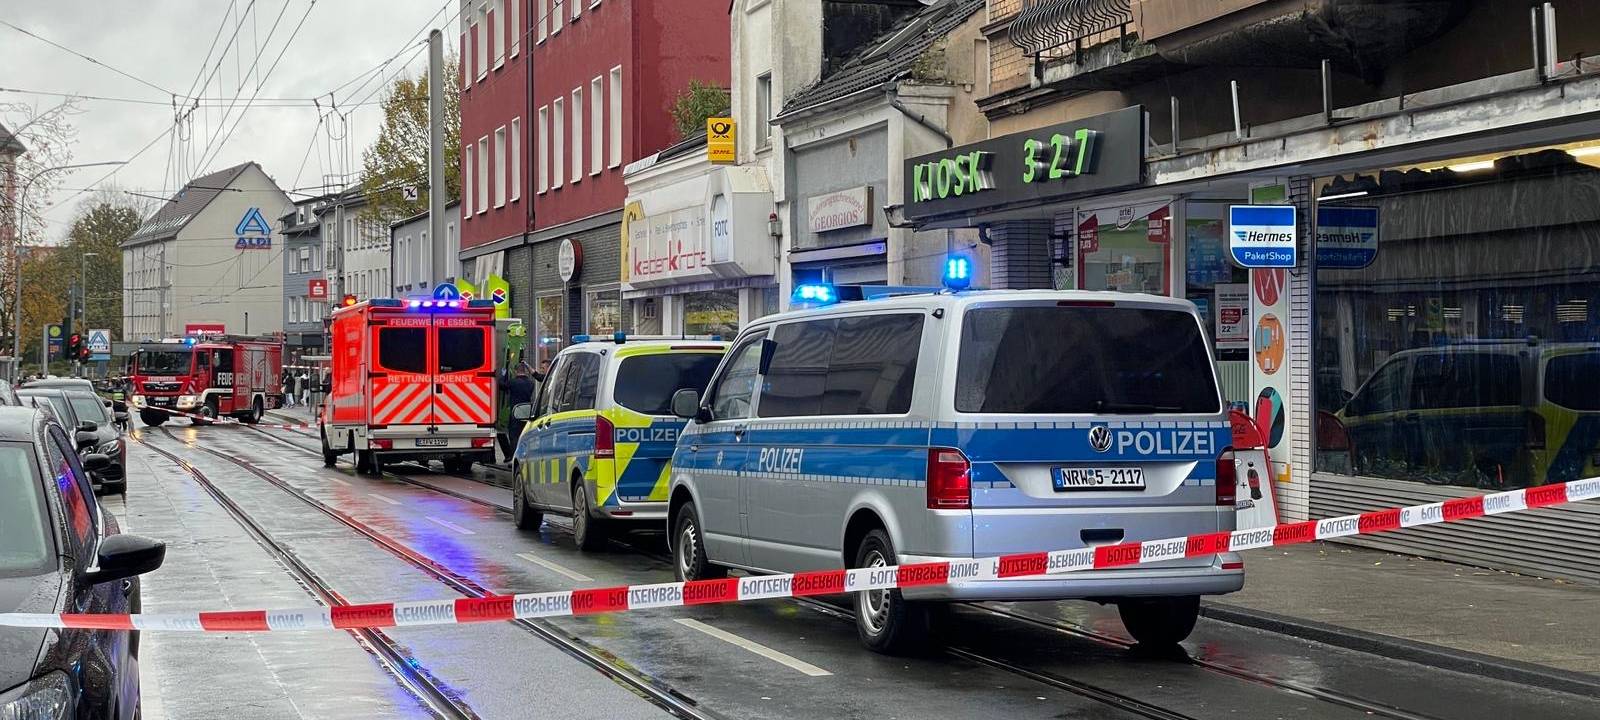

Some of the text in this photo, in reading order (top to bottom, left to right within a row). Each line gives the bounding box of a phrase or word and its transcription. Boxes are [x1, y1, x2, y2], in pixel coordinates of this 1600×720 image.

[913, 128, 1090, 203] KIOSK 327
[814, 210, 859, 230] GEORGIOS
[235, 238, 271, 249] ALDI
[1248, 231, 1293, 242] Hermes
[1244, 251, 1292, 262] PaketShop
[390, 318, 476, 326] FEUERWEHR ESSEN
[388, 374, 474, 383] RETTUNGSDIENST
[616, 428, 679, 442] POLIZEI
[1117, 430, 1215, 455] POLIZEI
[758, 447, 804, 473] POLIZEI
[1062, 468, 1142, 487] NRW 5-2117
